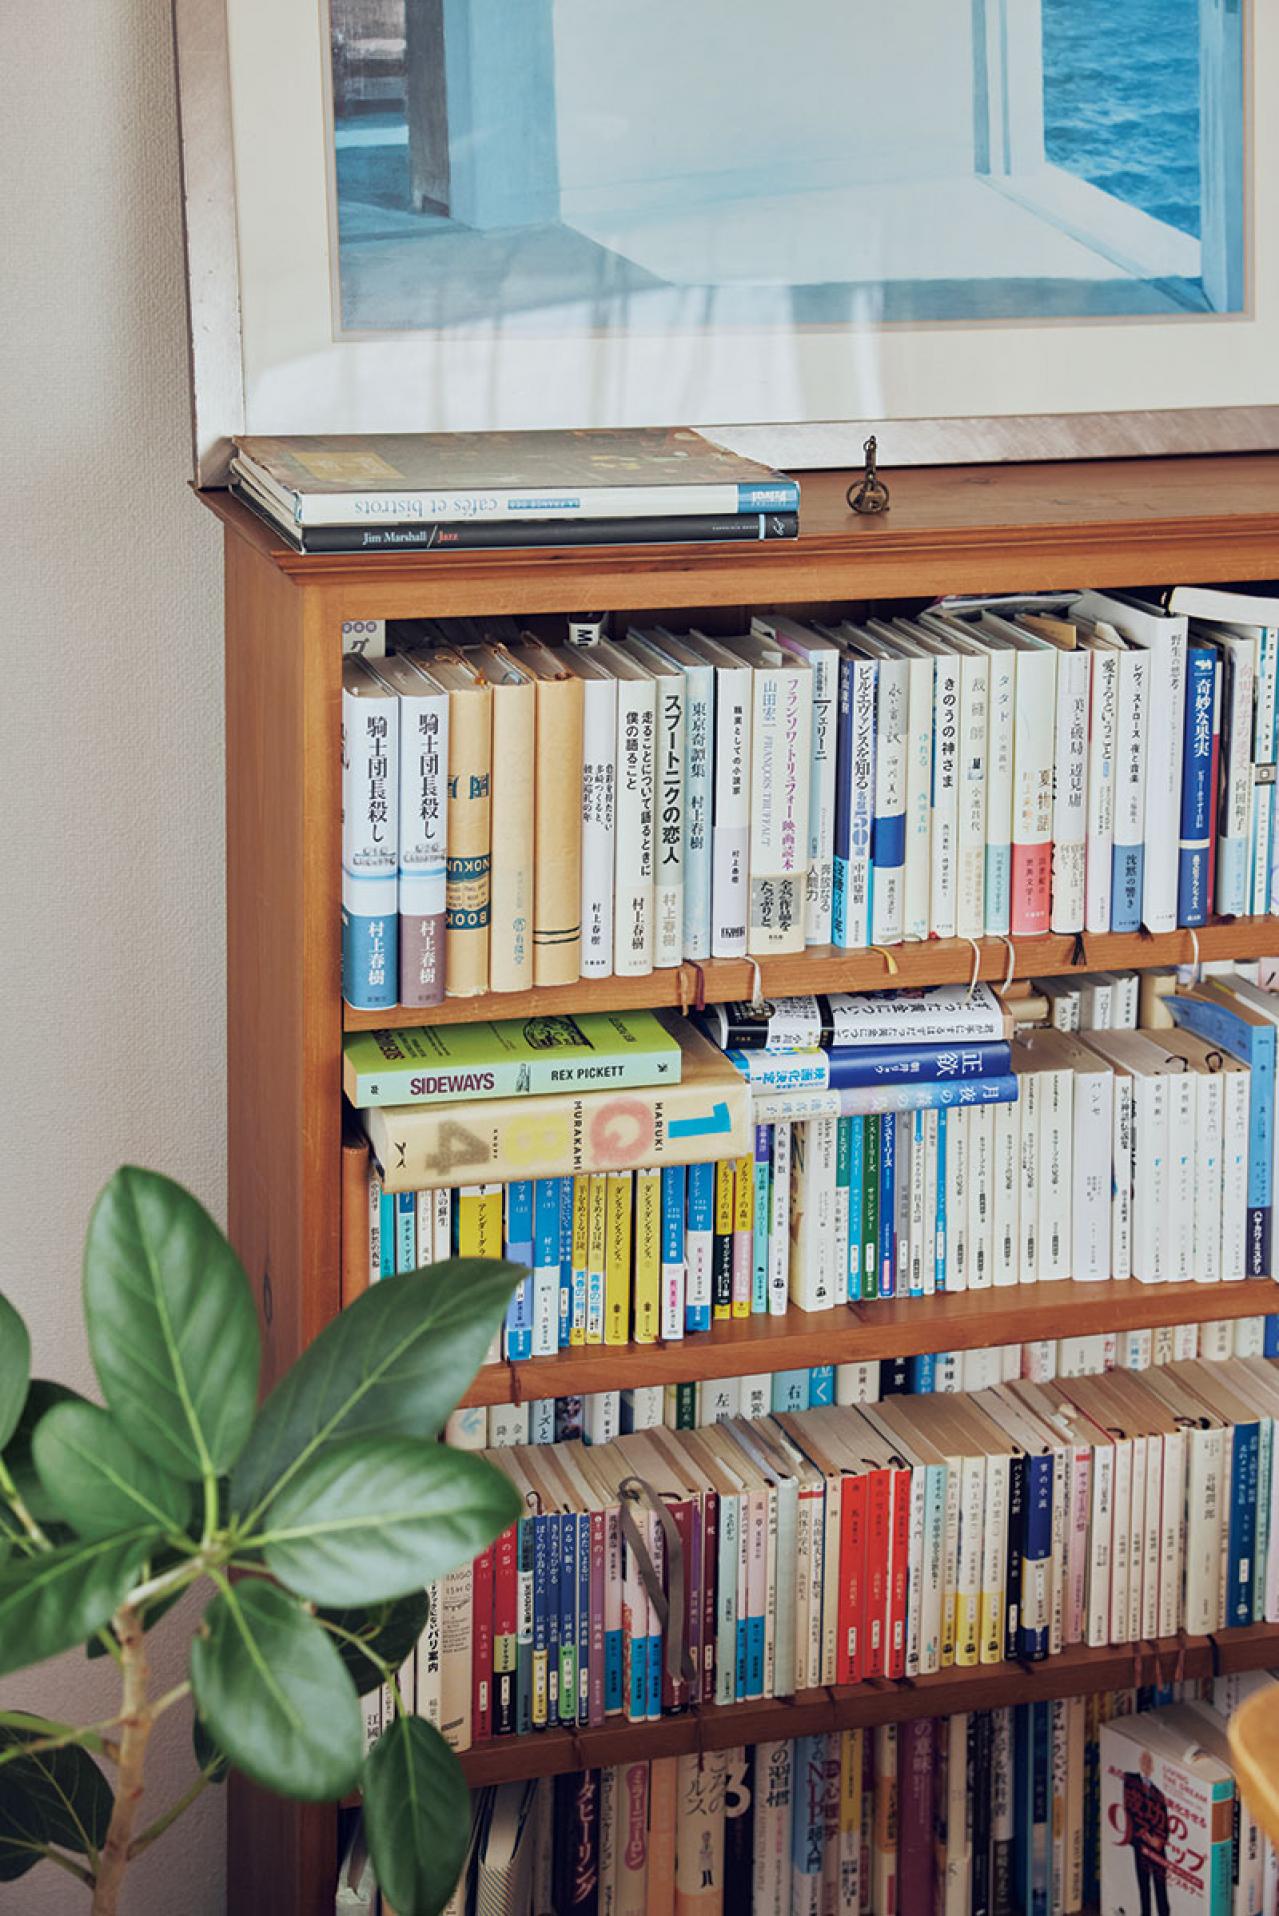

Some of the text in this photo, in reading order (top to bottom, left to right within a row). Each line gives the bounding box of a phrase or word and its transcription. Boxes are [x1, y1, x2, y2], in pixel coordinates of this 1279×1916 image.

[354, 500, 423, 518] bistrots
[431, 498, 447, 514] et
[453, 498, 499, 518] cafés
[362, 530, 459, 547] Jim Marshall Jazz
[762, 679, 778, 729] 山田宏一
[999, 674, 1010, 723] タタド
[1067, 697, 1084, 756] 美と破局
[1100, 658, 1115, 761] 愛するということ
[1193, 678, 1212, 759] 奇妙な果実
[625, 711, 639, 791] 僕の語ること
[690, 701, 706, 778] 東京奇譚集
[732, 704, 744, 796] 職業としての小説家
[943, 678, 957, 790] きのうの神さま
[367, 715, 388, 843] 騎士団長殺し
[418, 713, 439, 840] 騎士団長殺し
[640, 710, 653, 877] 走ることについて語るときに
[662, 693, 682, 865] スプートニクの恋人
[1037, 769, 1053, 833] 夏物語
[1067, 761, 1083, 809] 辺見庸
[689, 795, 705, 850] 村上春樹
[1125, 853, 1138, 911] 沈黙の響き
[590, 902, 602, 946] 村上春樹
[631, 896, 645, 951] 村上春樹
[662, 892, 678, 948] 村上春樹
[368, 919, 385, 986] 村上春樹
[420, 918, 436, 985] 村上春樹
[409, 1071, 495, 1096] SIDEWAYS
[550, 1064, 625, 1082] REX PICKETT
[935, 1050, 984, 1078] 正欲
[654, 1101, 664, 1152] HARUKI
[1091, 1082, 1102, 1116] パンセ
[572, 1099, 583, 1171] MURAKAMI
[739, 1159, 749, 1219] ノルウェイの森
[536, 1524, 545, 1596] ぼくの小鳥ちゃん
[550, 1524, 559, 1585] きらきらひかる
[564, 1523, 574, 1574] ぬるい眠り
[580, 1522, 588, 1583] つめたいよるに
